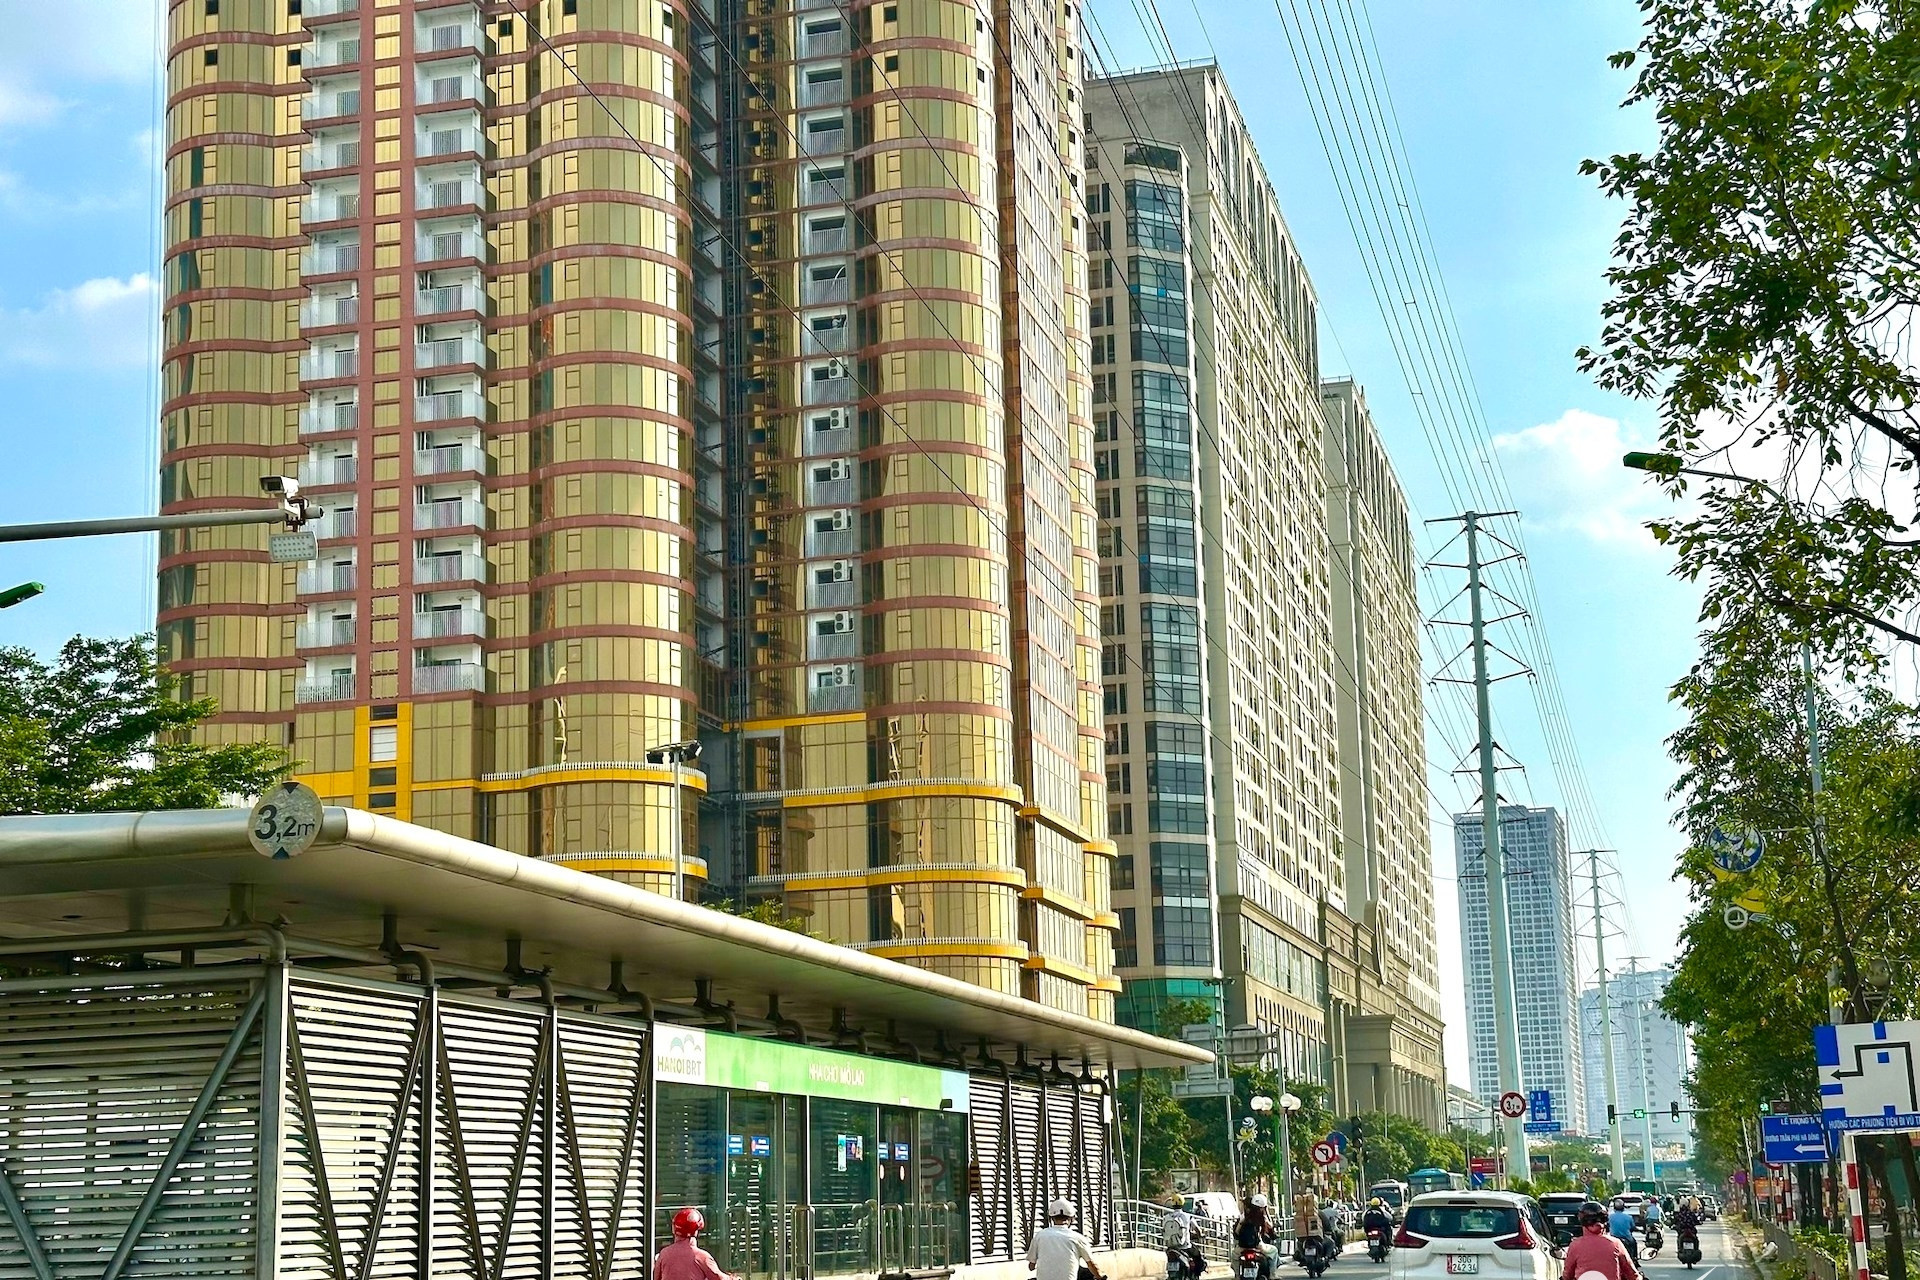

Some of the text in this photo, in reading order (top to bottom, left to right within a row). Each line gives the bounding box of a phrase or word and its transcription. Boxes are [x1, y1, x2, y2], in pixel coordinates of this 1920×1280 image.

[657, 1055, 702, 1076] HANOI BRT
[1457, 1255, 1472, 1264] 30G
